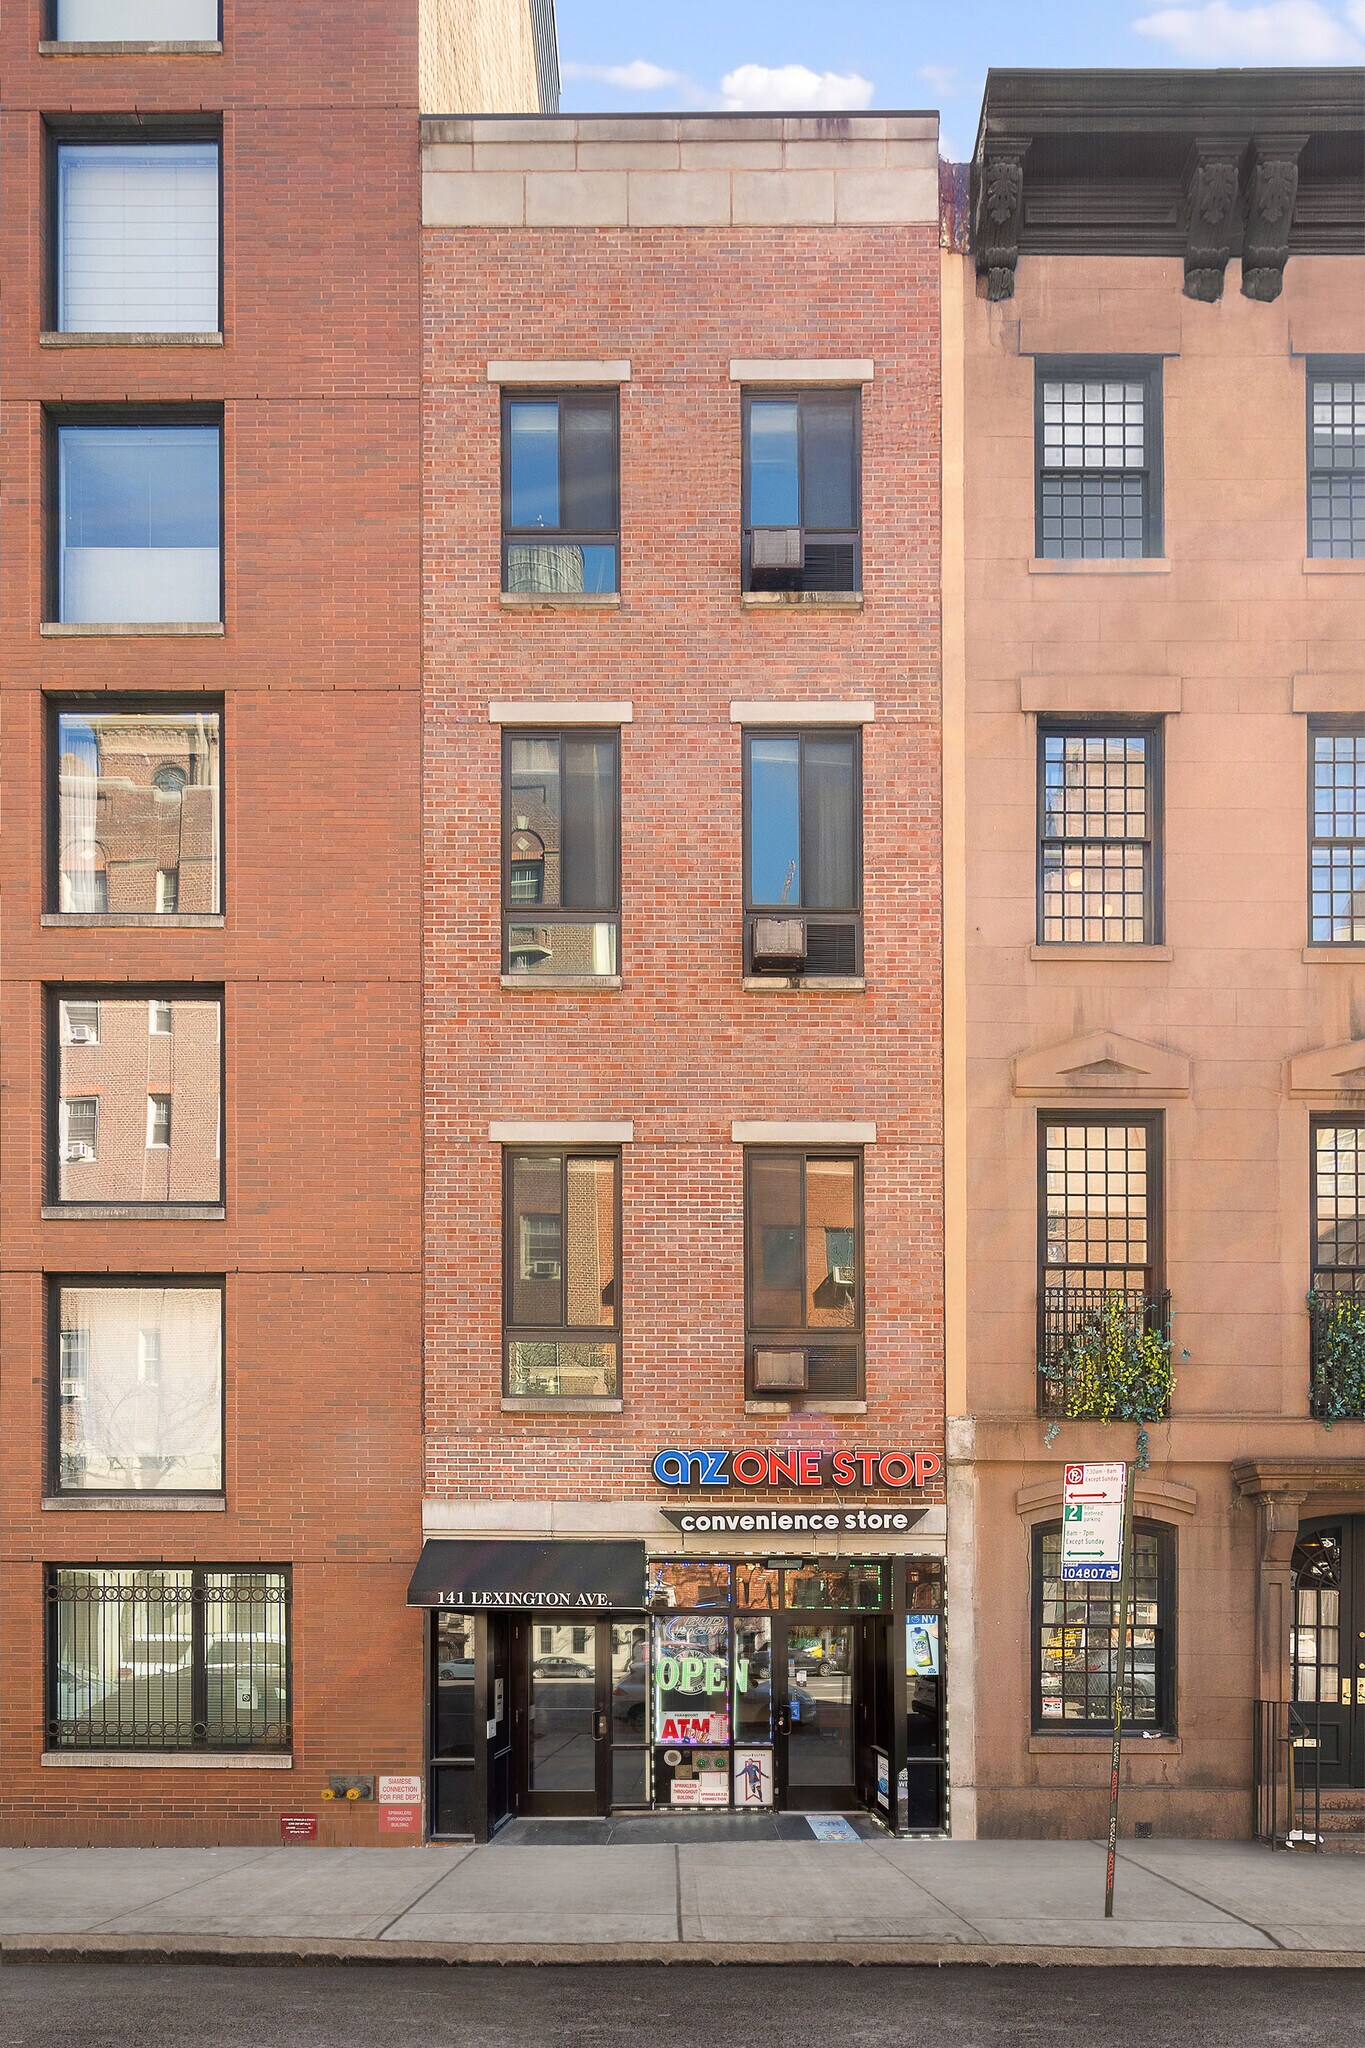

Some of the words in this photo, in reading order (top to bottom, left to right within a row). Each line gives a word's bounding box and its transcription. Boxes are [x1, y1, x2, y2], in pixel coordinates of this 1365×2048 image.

[732, 1450, 822, 1486] ONE
[832, 1450, 941, 1487] STOP
[1068, 1505, 1078, 1520] 2
[680, 1511, 840, 1531] convenience
[844, 1510, 908, 1530] store
[1064, 1568, 1105, 1578] 104807
[438, 1592, 465, 1604] 141
[471, 1592, 572, 1605] LEXINGTON
[575, 1593, 613, 1606] AVE.
[685, 1615, 724, 1626] BUD
[922, 1615, 934, 1623] NY
[656, 1657, 749, 1694] OPEN
[661, 1718, 710, 1739] ATM
